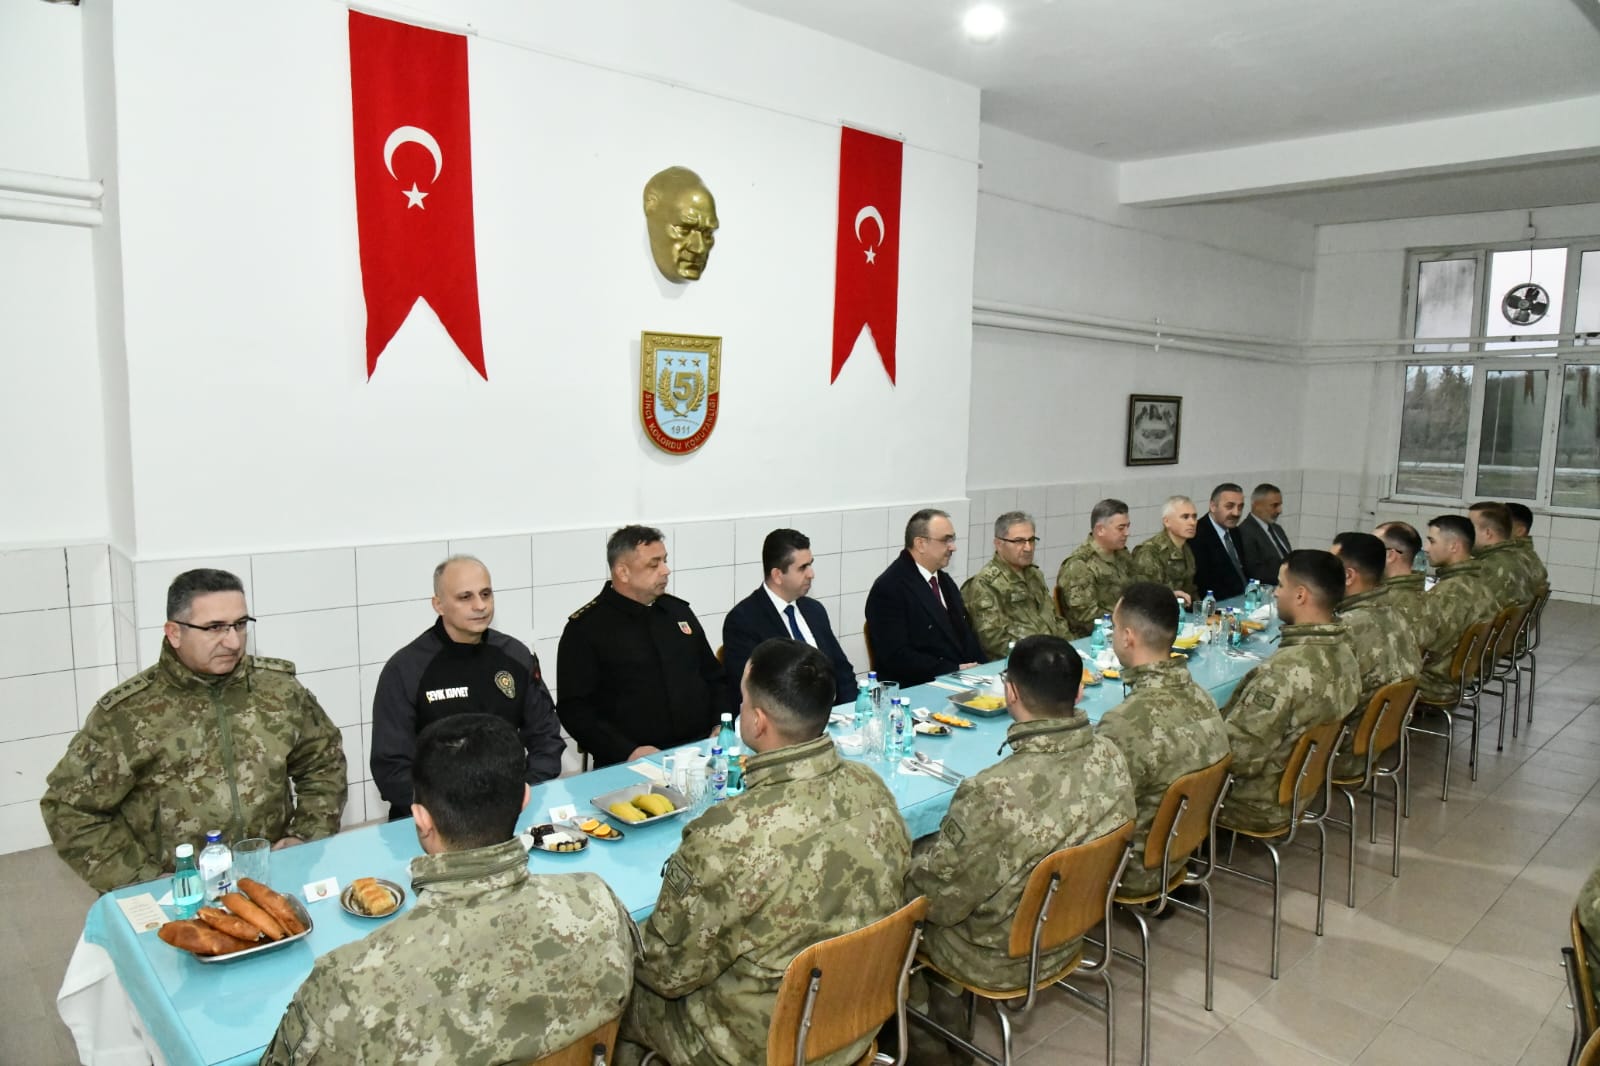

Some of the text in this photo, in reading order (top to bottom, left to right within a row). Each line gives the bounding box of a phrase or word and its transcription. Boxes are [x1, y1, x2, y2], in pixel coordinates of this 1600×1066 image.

[674, 372, 692, 400] 5
[649, 423, 682, 450] KOLORDU
[671, 425, 690, 434] 1911
[445, 686, 469, 699] KUVVET
